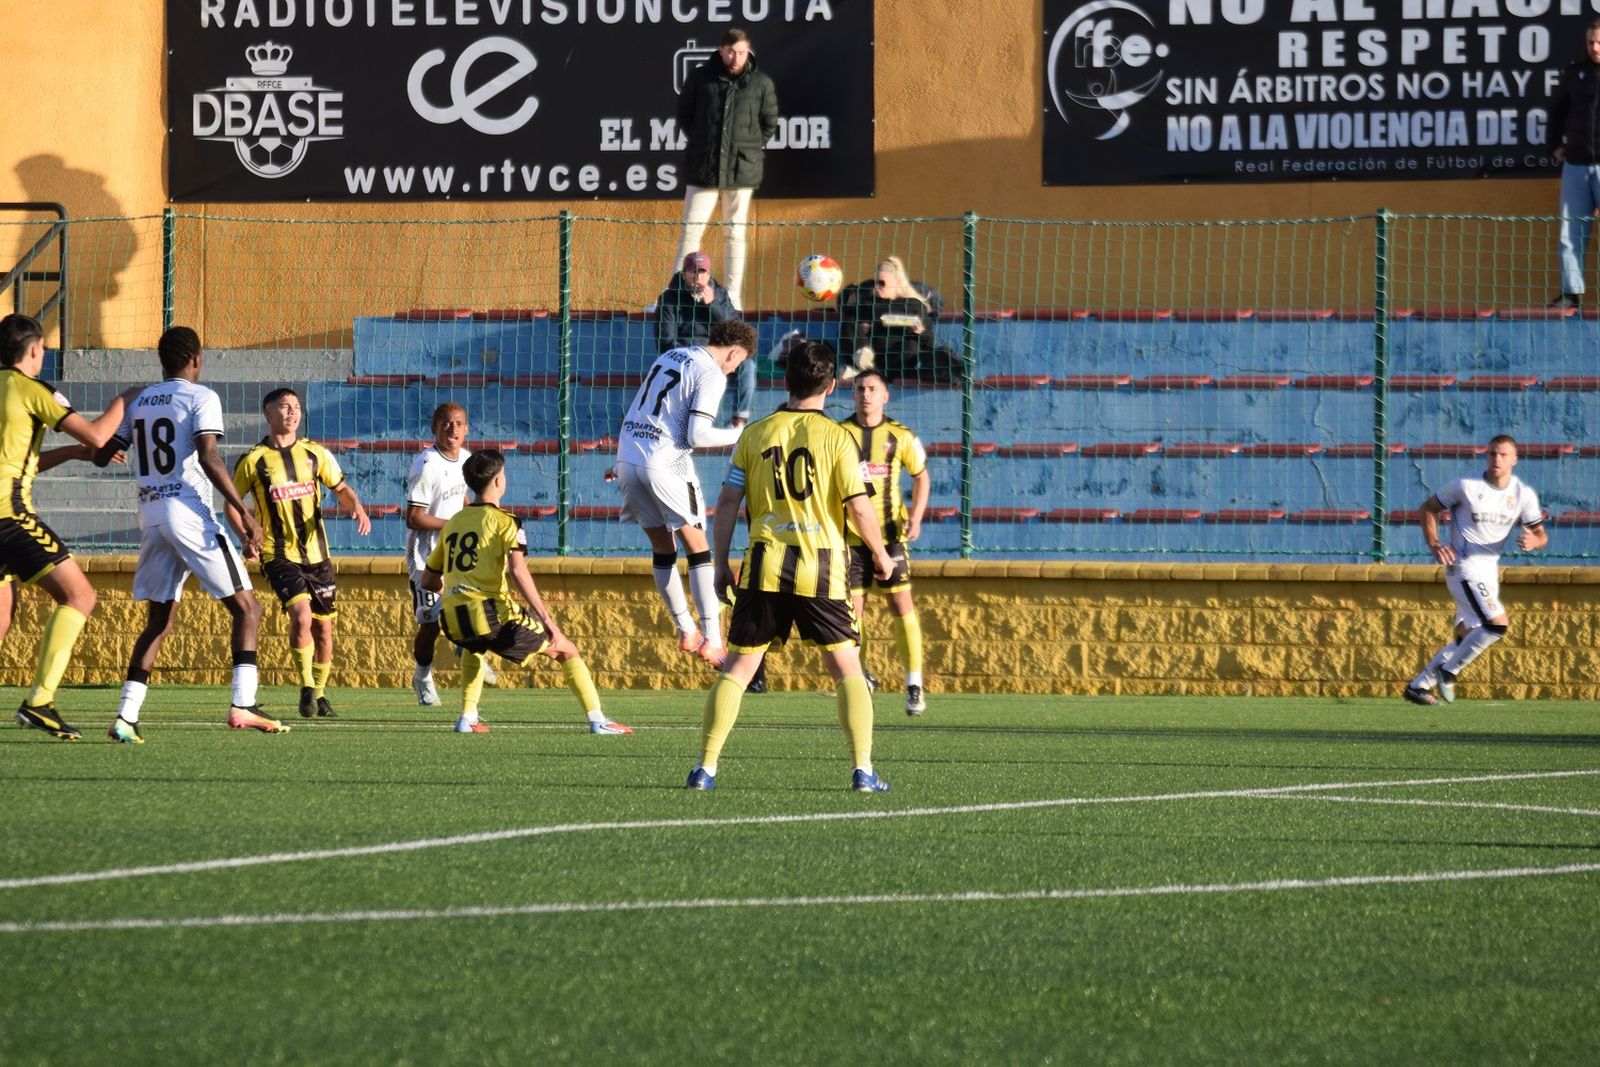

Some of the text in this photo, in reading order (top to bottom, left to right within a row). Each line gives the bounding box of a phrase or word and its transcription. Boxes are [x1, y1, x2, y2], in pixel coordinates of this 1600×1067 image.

[1279, 25, 1549, 68] RESPETO
[257, 80, 282, 89] RFFCE
[1165, 77, 1217, 105] SIN
[1229, 68, 1385, 103] ÁRBITROS
[1397, 71, 1450, 100] NO
[1462, 70, 1532, 98] HAY
[193, 92, 343, 136] DBASE
[1167, 114, 1212, 151] NO
[1219, 115, 1242, 150] A
[1249, 114, 1288, 150] LA
[1294, 110, 1469, 149] VIOLENCIA
[1476, 109, 1518, 145] DE
[600, 118, 641, 151] EL
[344, 159, 677, 193] www.rtvce.es
[1234, 160, 1274, 173] Real
[1282, 157, 1386, 172] Federación
[1395, 158, 1417, 170] de
[1427, 155, 1483, 169] Fútbol
[1492, 156, 1516, 168] de
[638, 364, 681, 416] 17
[133, 417, 176, 477] 18
[761, 445, 815, 501] 10
[445, 531, 479, 573] 18
[419, 591, 436, 607] 19
[1477, 582, 1489, 597] 8
